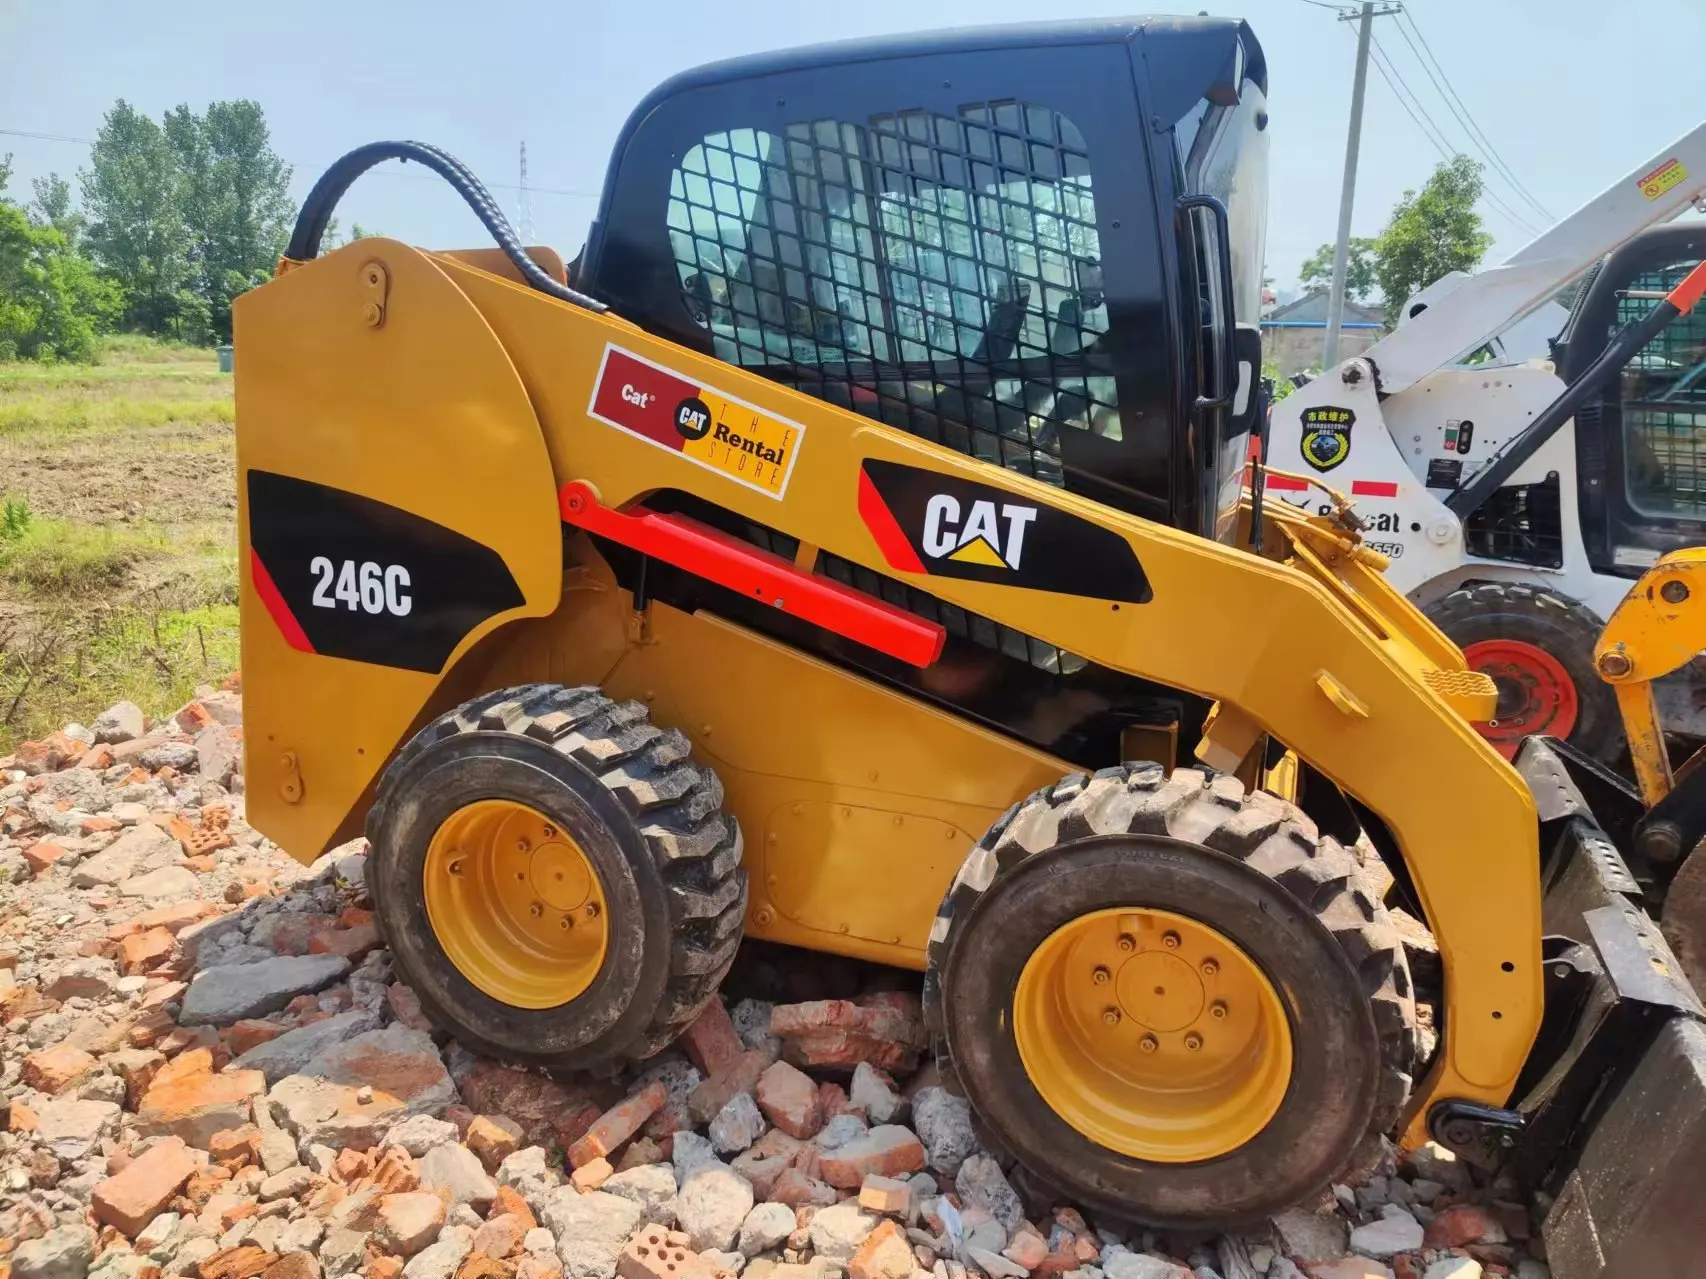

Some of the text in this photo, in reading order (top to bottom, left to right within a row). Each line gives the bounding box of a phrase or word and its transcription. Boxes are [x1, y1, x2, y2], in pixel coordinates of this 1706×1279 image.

[679, 406, 707, 431] CAT
[718, 403, 791, 447] THE
[1307, 411, 1349, 422] 市政维护
[707, 441, 779, 485] STORE
[712, 422, 785, 466] Rental
[922, 493, 1038, 571] CAT
[310, 556, 412, 617] 246C
